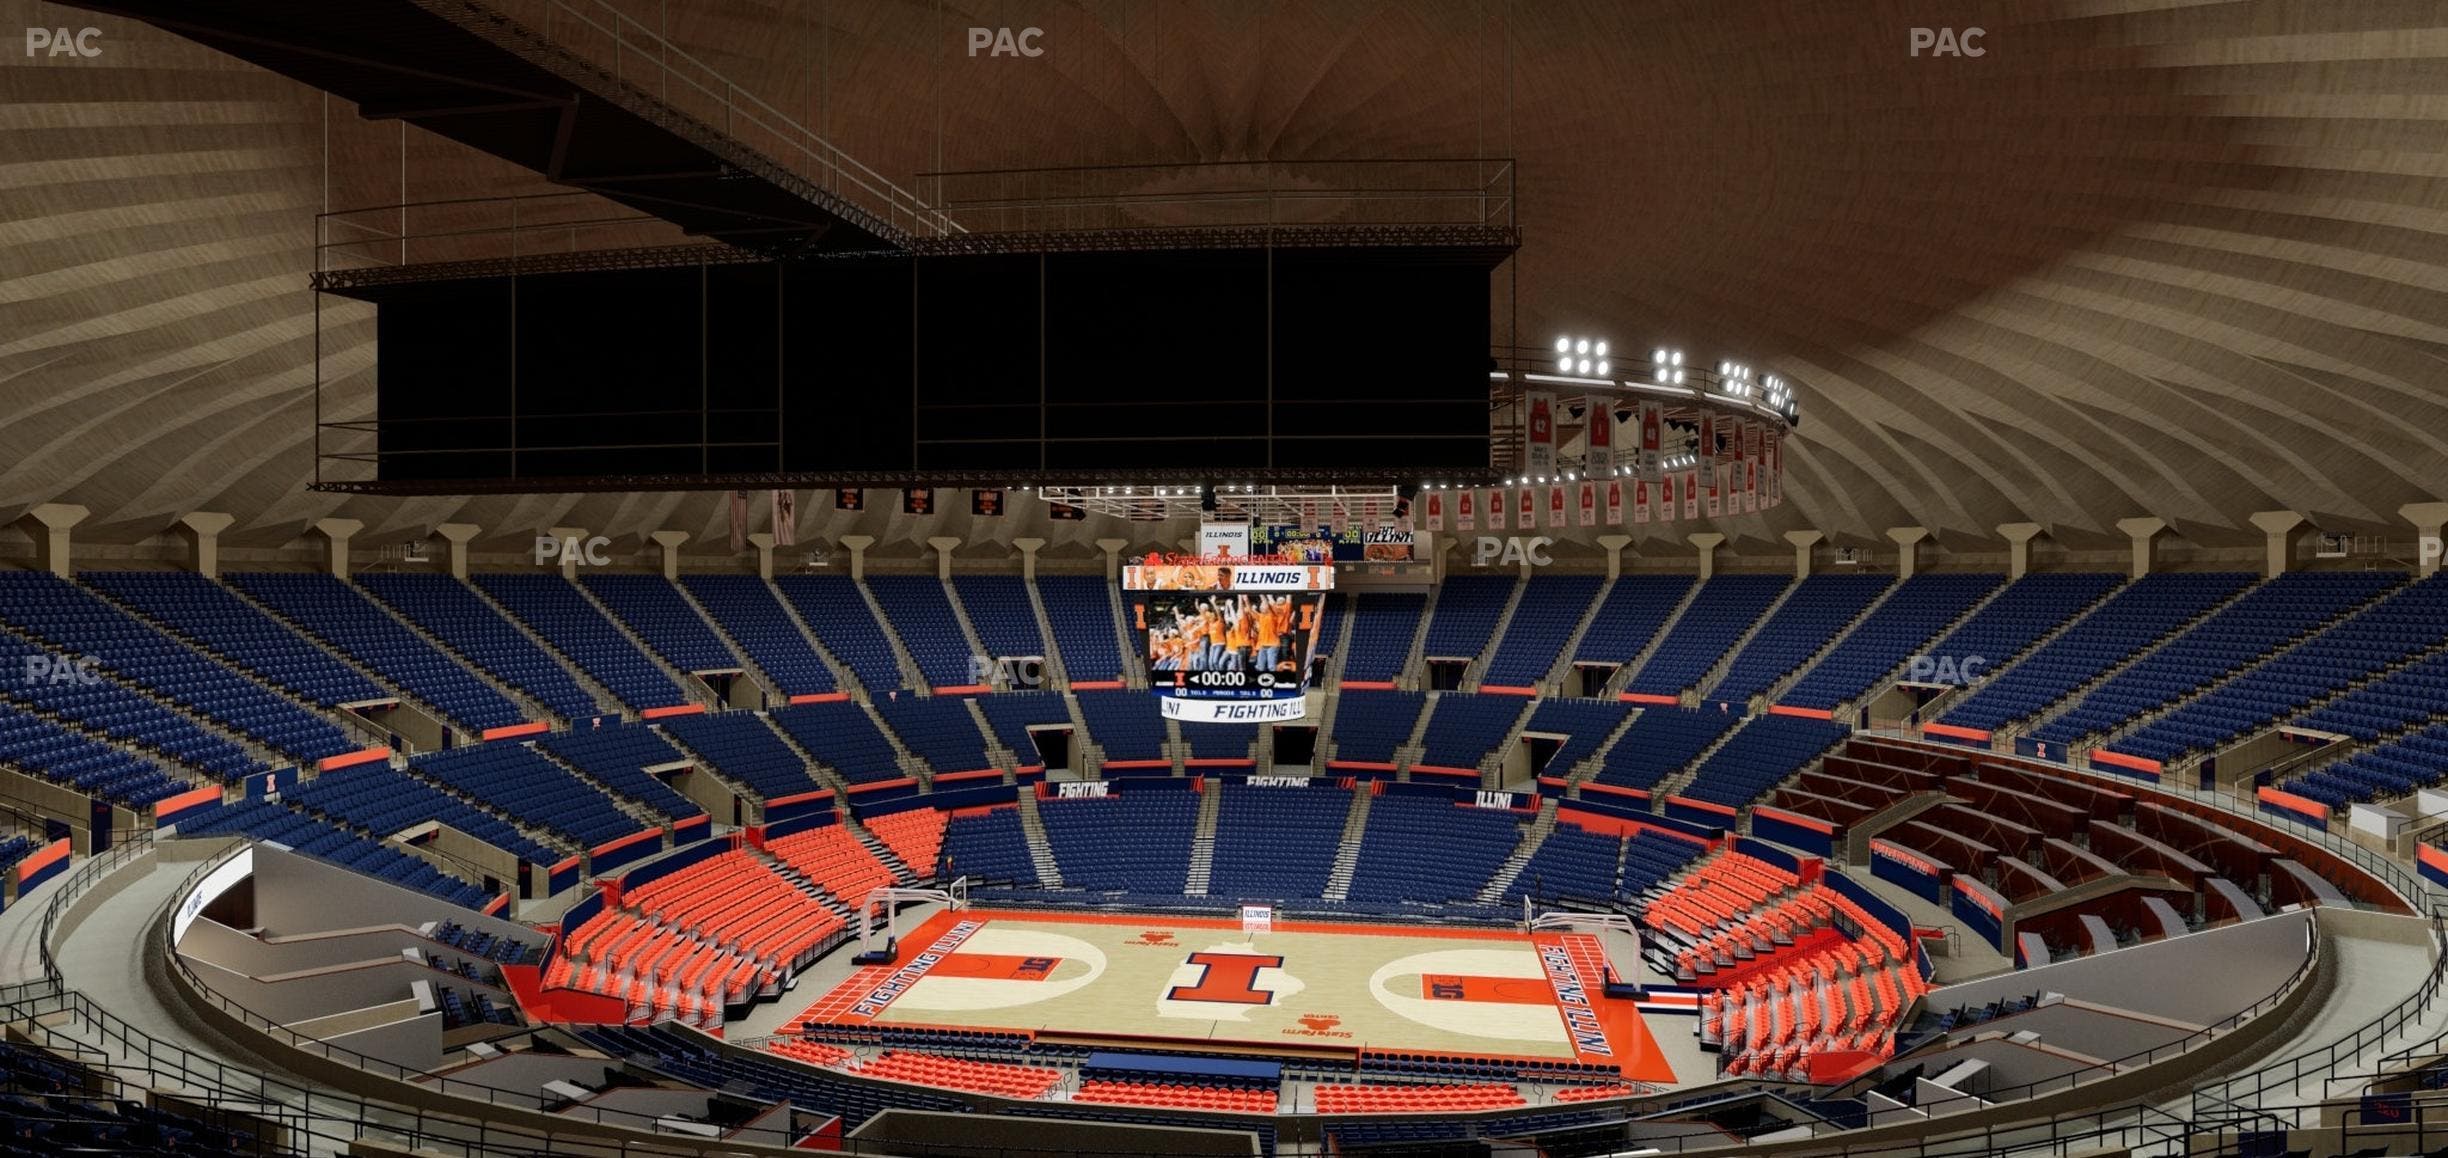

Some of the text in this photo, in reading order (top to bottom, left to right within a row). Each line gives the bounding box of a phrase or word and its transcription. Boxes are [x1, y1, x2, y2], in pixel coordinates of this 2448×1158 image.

[1235, 572, 1302, 584] ILLINOIS
[1201, 671, 1246, 686] 00:00
[1175, 687, 1187, 697] 00
[1213, 702, 1288, 719] FIGHTING
[1058, 781, 1109, 798] FIGHTING
[1246, 775, 1311, 788] FIGHTING
[1475, 790, 1513, 810] ILLINI
[930, 920, 982, 954] ILLINI
[1538, 944, 1591, 1007] FIGHTING
[851, 952, 940, 1017] FIGHTING
[1562, 1005, 1614, 1057] ILLINI
